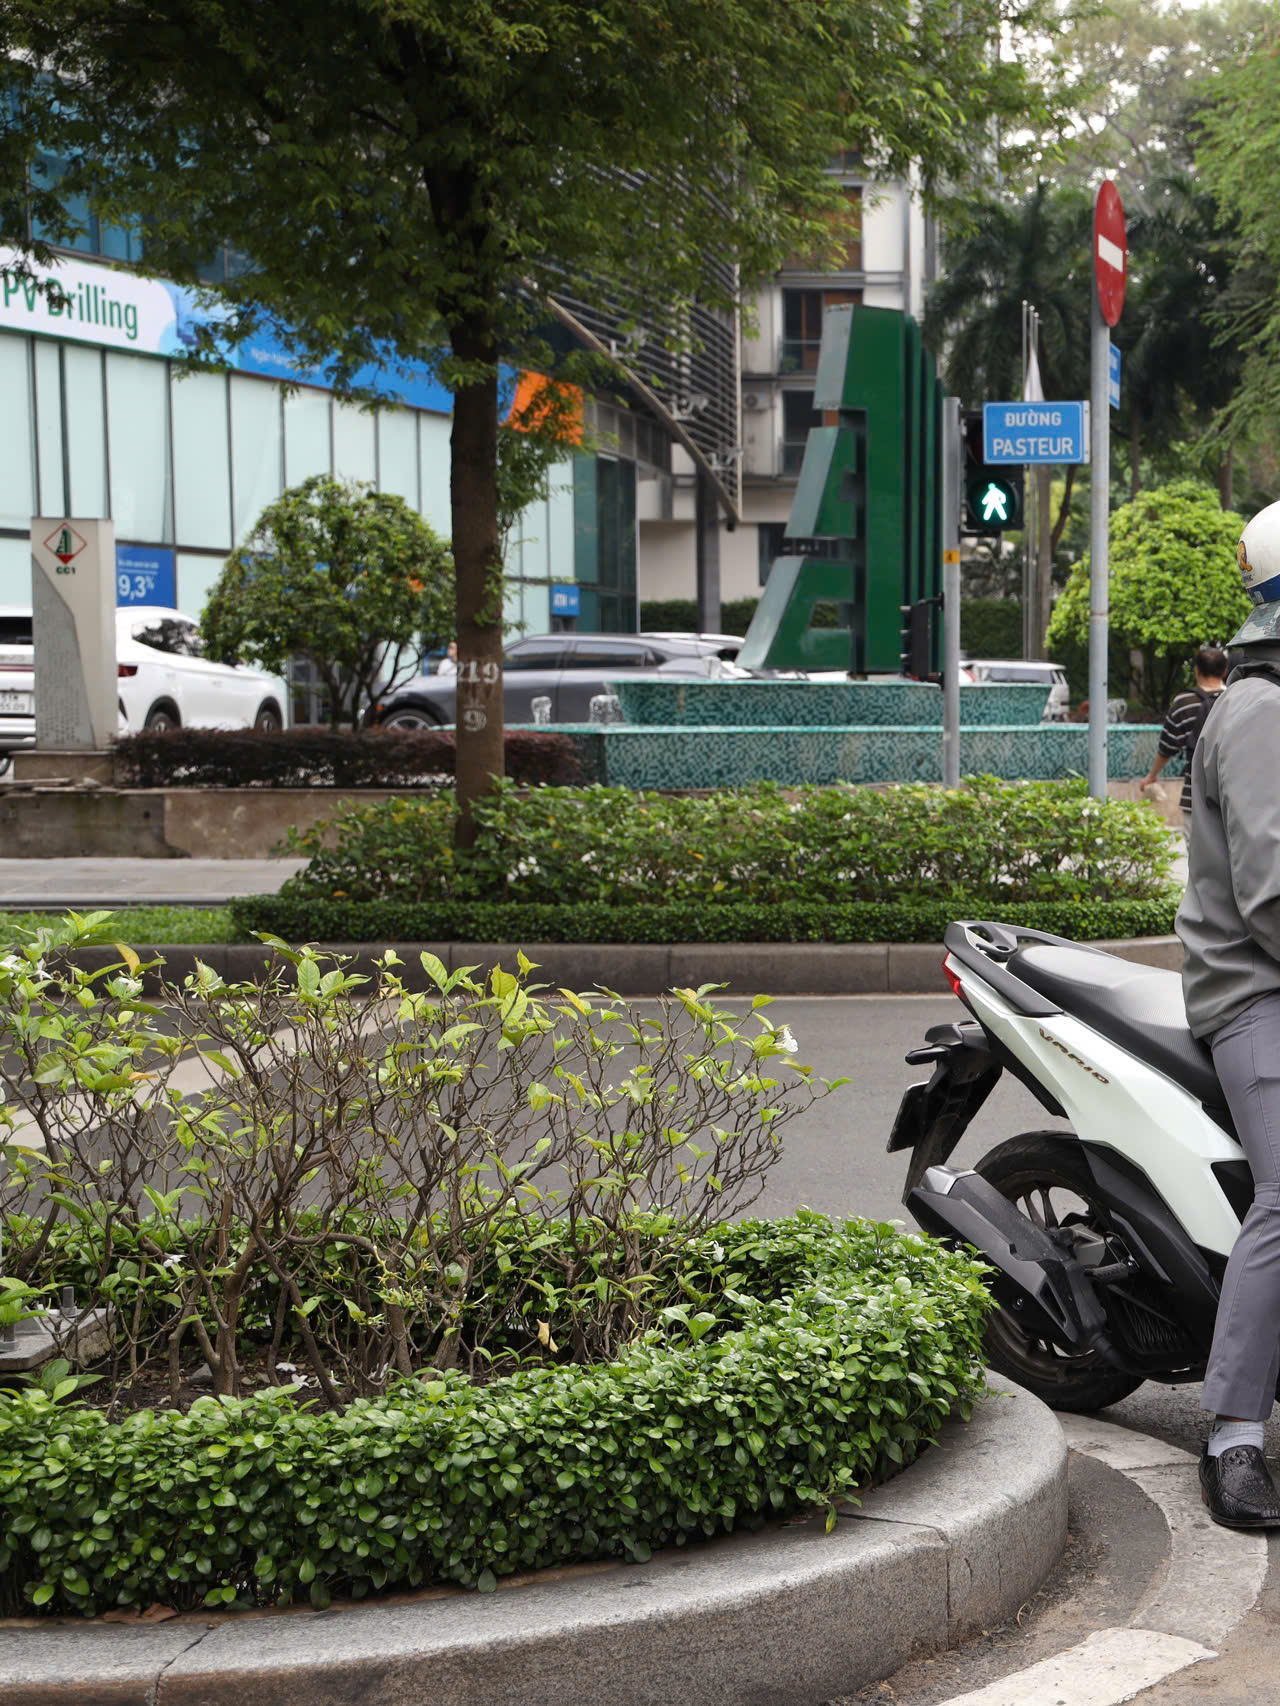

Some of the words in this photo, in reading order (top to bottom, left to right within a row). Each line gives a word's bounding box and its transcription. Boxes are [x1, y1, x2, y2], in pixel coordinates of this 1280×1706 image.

[3, 268, 37, 313] PV
[45, 277, 138, 341] Drilling
[1005, 409, 1062, 427] ĐƯỜNG
[992, 437, 1074, 456] PASTEUR
[1039, 1027, 1110, 1084] VARIO
